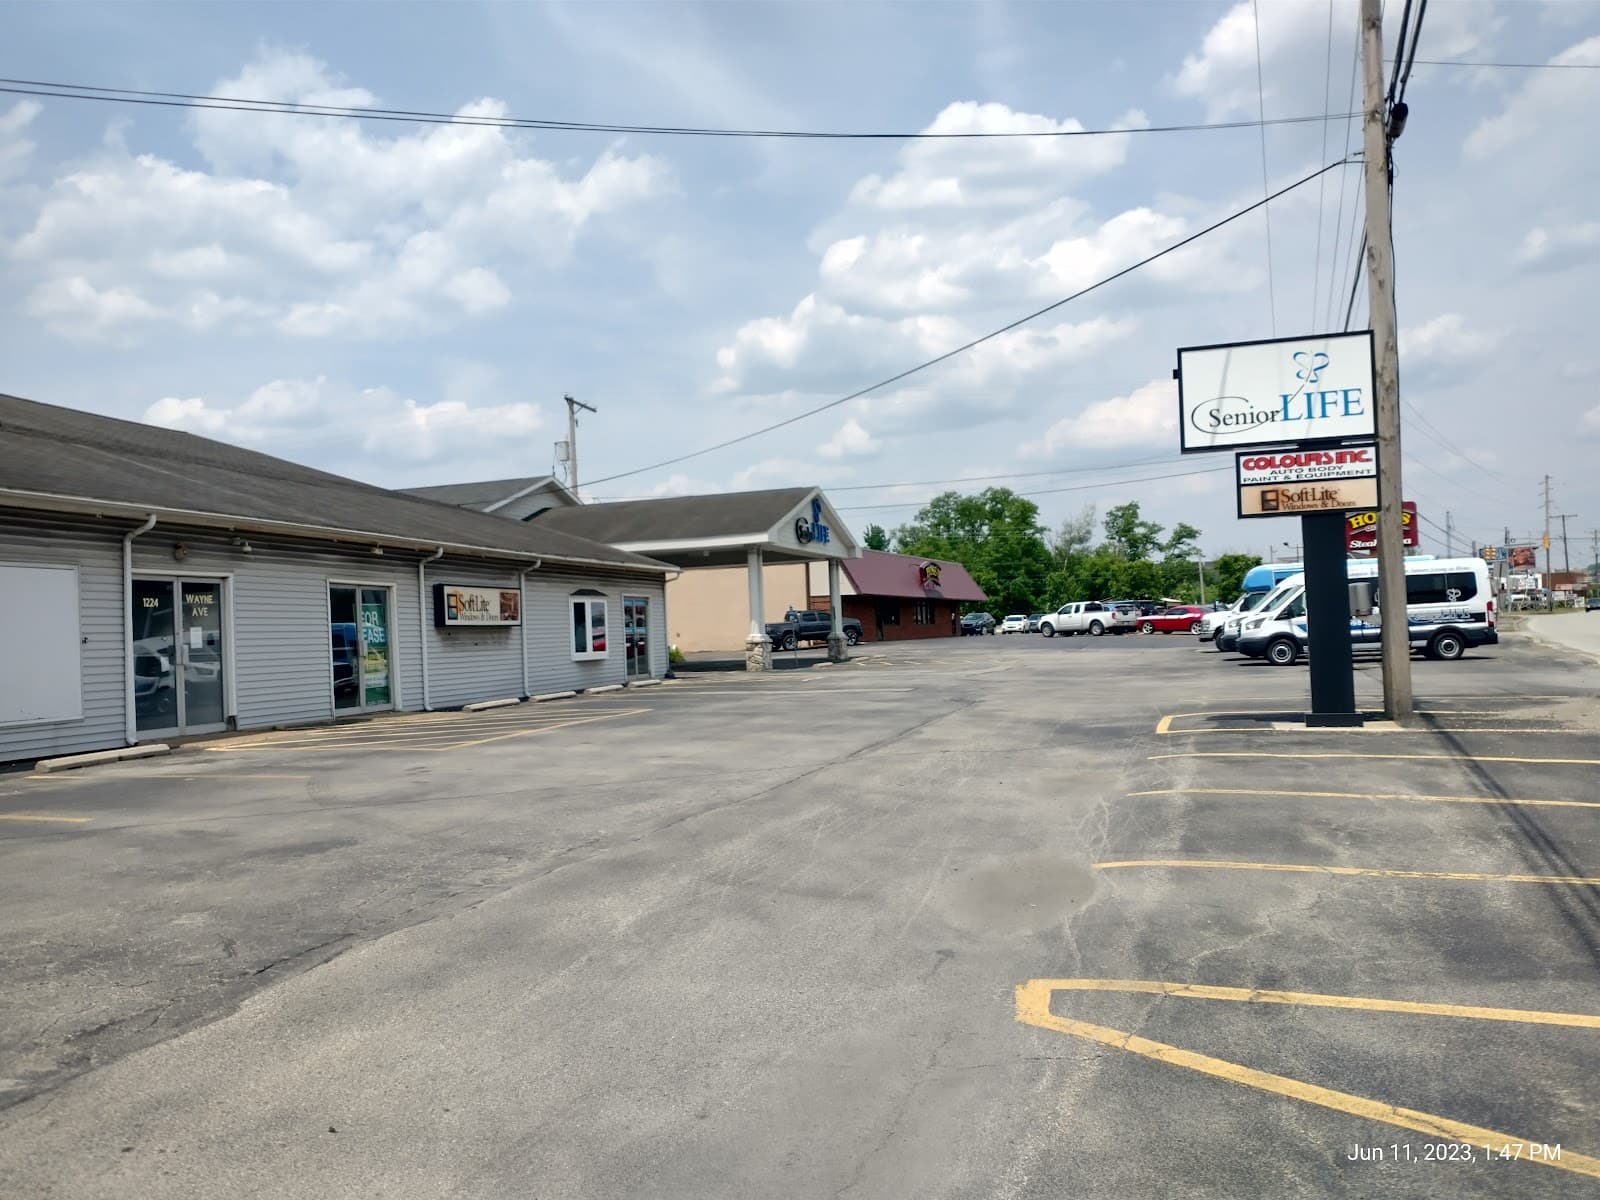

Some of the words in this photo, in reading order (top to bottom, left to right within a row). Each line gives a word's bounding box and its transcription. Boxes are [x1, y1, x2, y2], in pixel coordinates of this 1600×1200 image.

[1208, 406, 1280, 428] Senior
[1279, 388, 1365, 422] LIFE
[1242, 451, 1334, 471] COLOURS
[1243, 475, 1280, 483] PAINT
[1296, 469, 1373, 479] EQUIPMENT
[1270, 467, 1304, 475] AUTO
[1282, 502, 1318, 511] Windows
[1331, 499, 1356, 507] Doors
[143, 598, 159, 608] 1224
[186, 594, 214, 604] WAYNE
[192, 607, 209, 617] AVE
[362, 627, 386, 643] EASE
